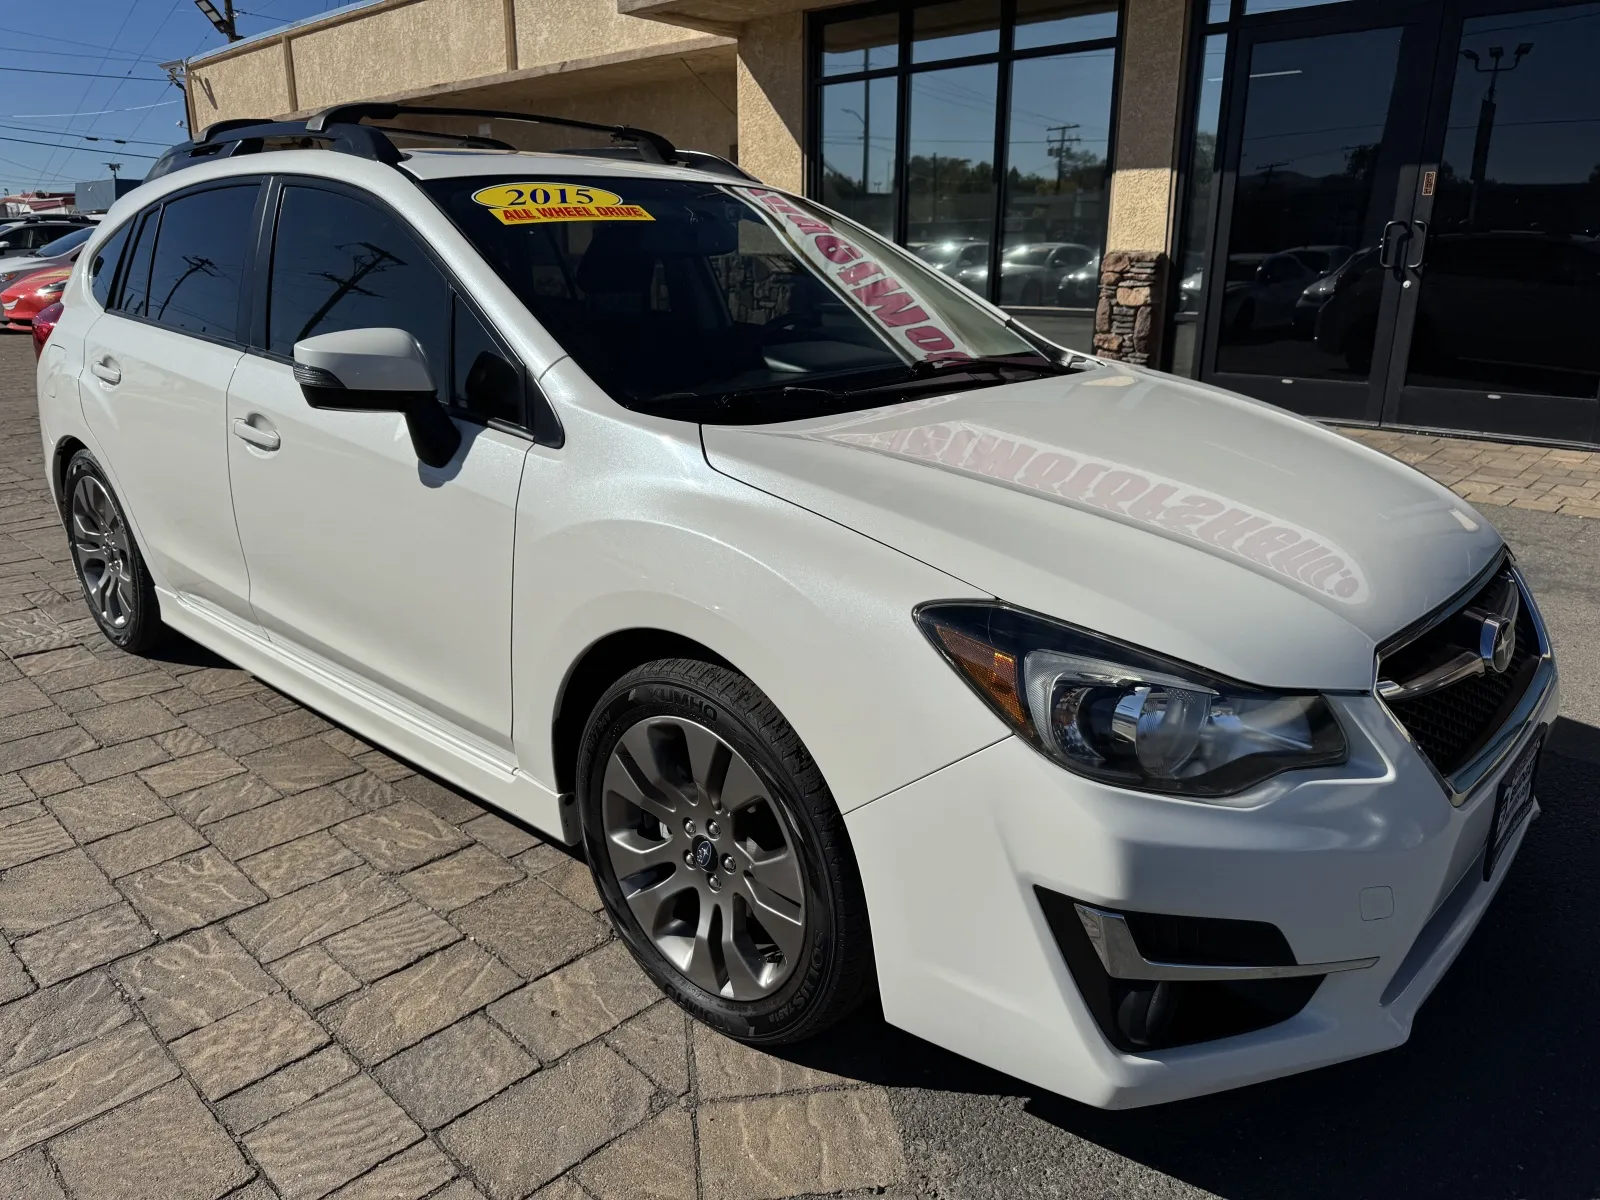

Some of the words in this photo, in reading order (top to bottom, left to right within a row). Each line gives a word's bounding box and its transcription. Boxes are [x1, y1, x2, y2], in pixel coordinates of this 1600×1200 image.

[505, 188, 594, 206] 2015
[503, 208, 536, 221] ALL
[538, 206, 595, 219] WHEEL
[599, 205, 645, 218] DRIVE
[648, 687, 718, 722] KUMHO
[793, 928, 824, 1009] SOLUS
